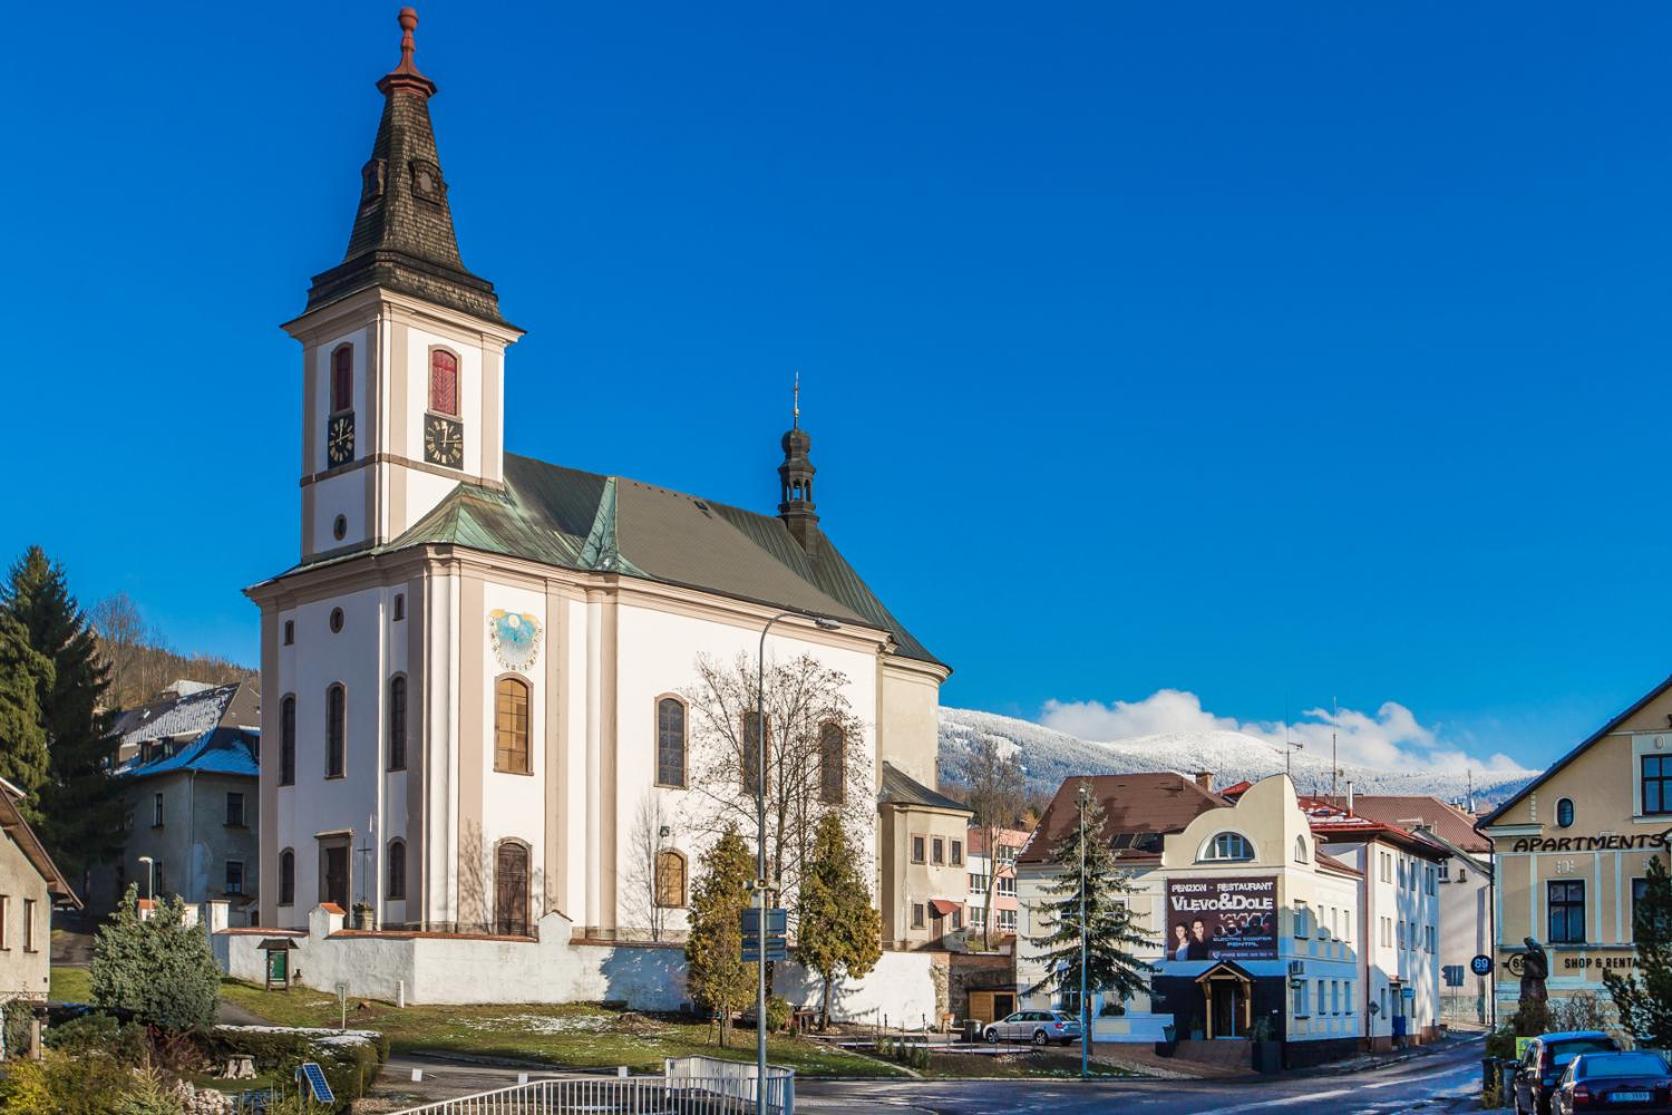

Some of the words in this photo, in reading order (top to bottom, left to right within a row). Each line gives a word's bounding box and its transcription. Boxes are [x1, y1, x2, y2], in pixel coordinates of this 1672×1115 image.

[1514, 834, 1664, 852] APARTMENTS
[1172, 884, 1206, 892] PENZION
[1217, 882, 1272, 891] RESTAURANT
[1474, 958, 1488, 969] 69
[1564, 958, 1592, 968] SHOP
[1606, 957, 1641, 968] RENTA
